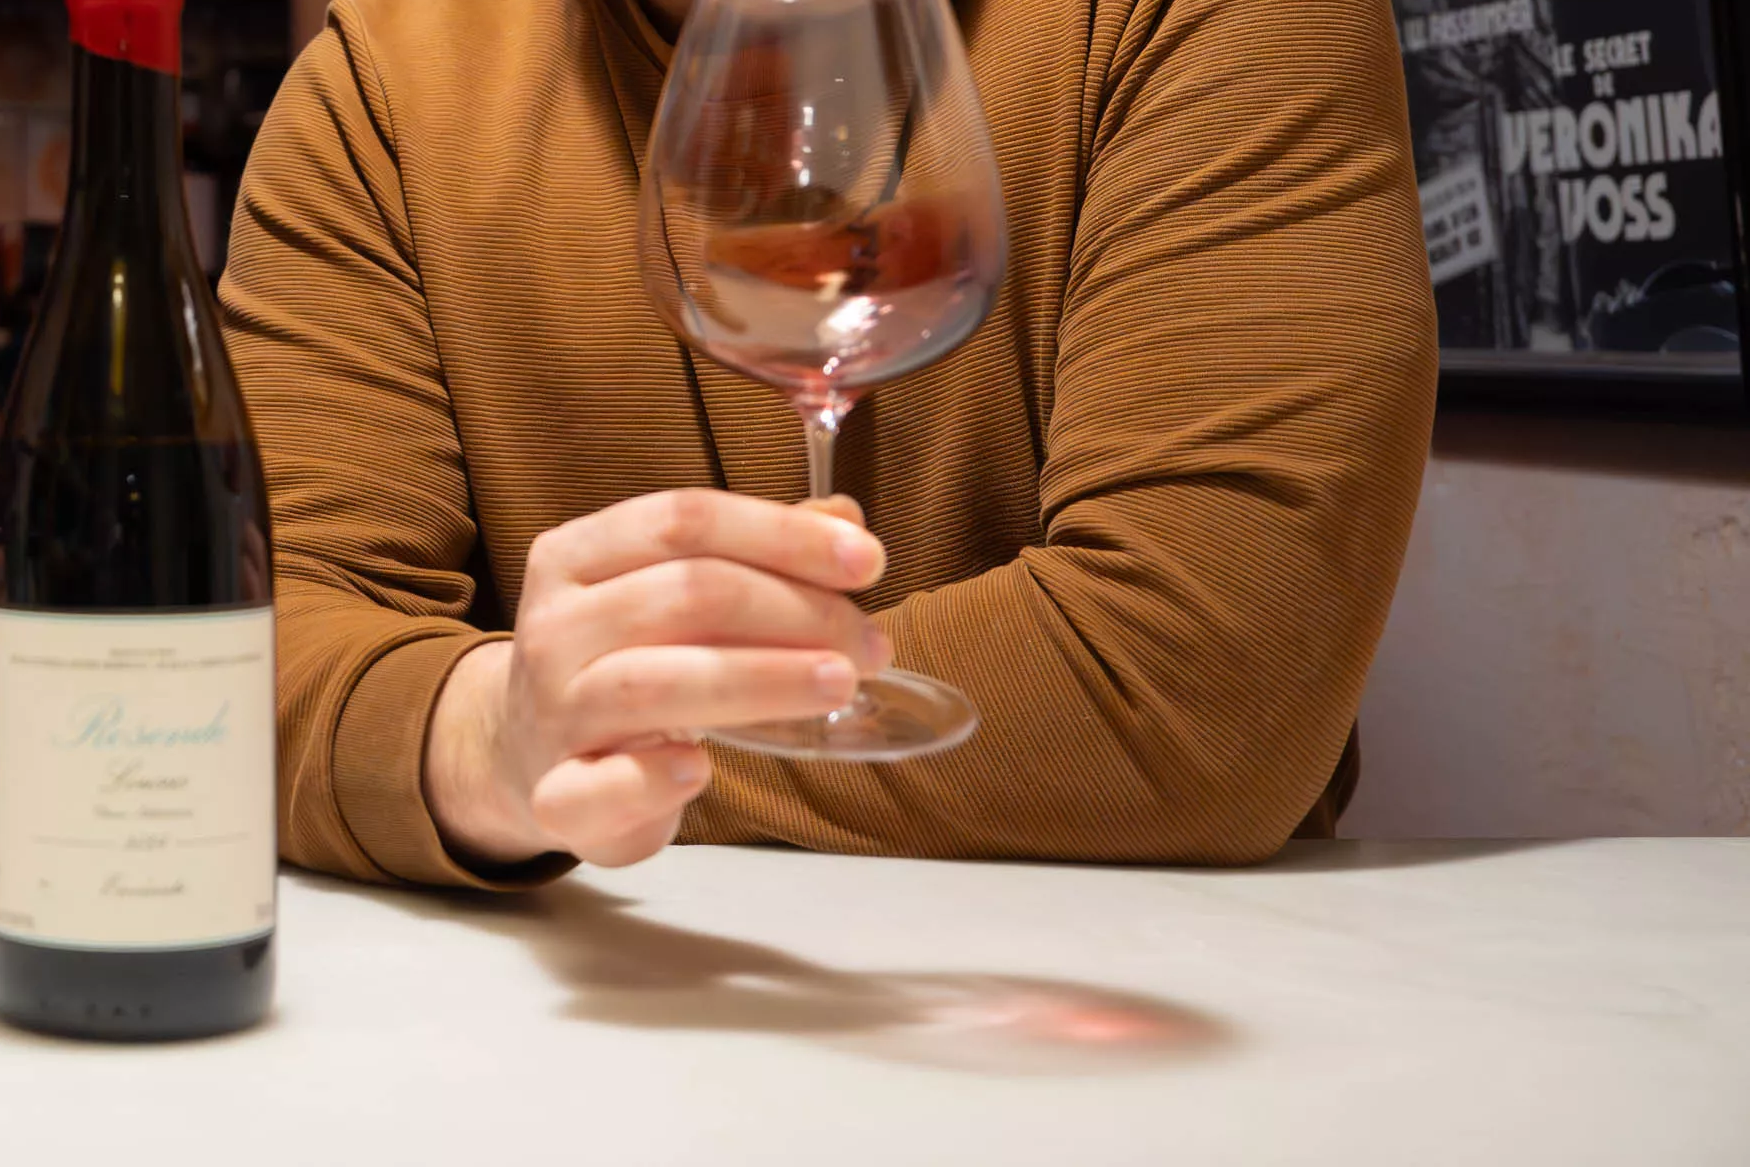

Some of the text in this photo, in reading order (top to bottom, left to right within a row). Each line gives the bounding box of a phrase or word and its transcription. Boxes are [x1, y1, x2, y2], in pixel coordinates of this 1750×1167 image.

[1551, 30, 1654, 78] LE SECRET
[1500, 89, 1725, 177] VERONIKA
[1557, 171, 1677, 244] VOSS
